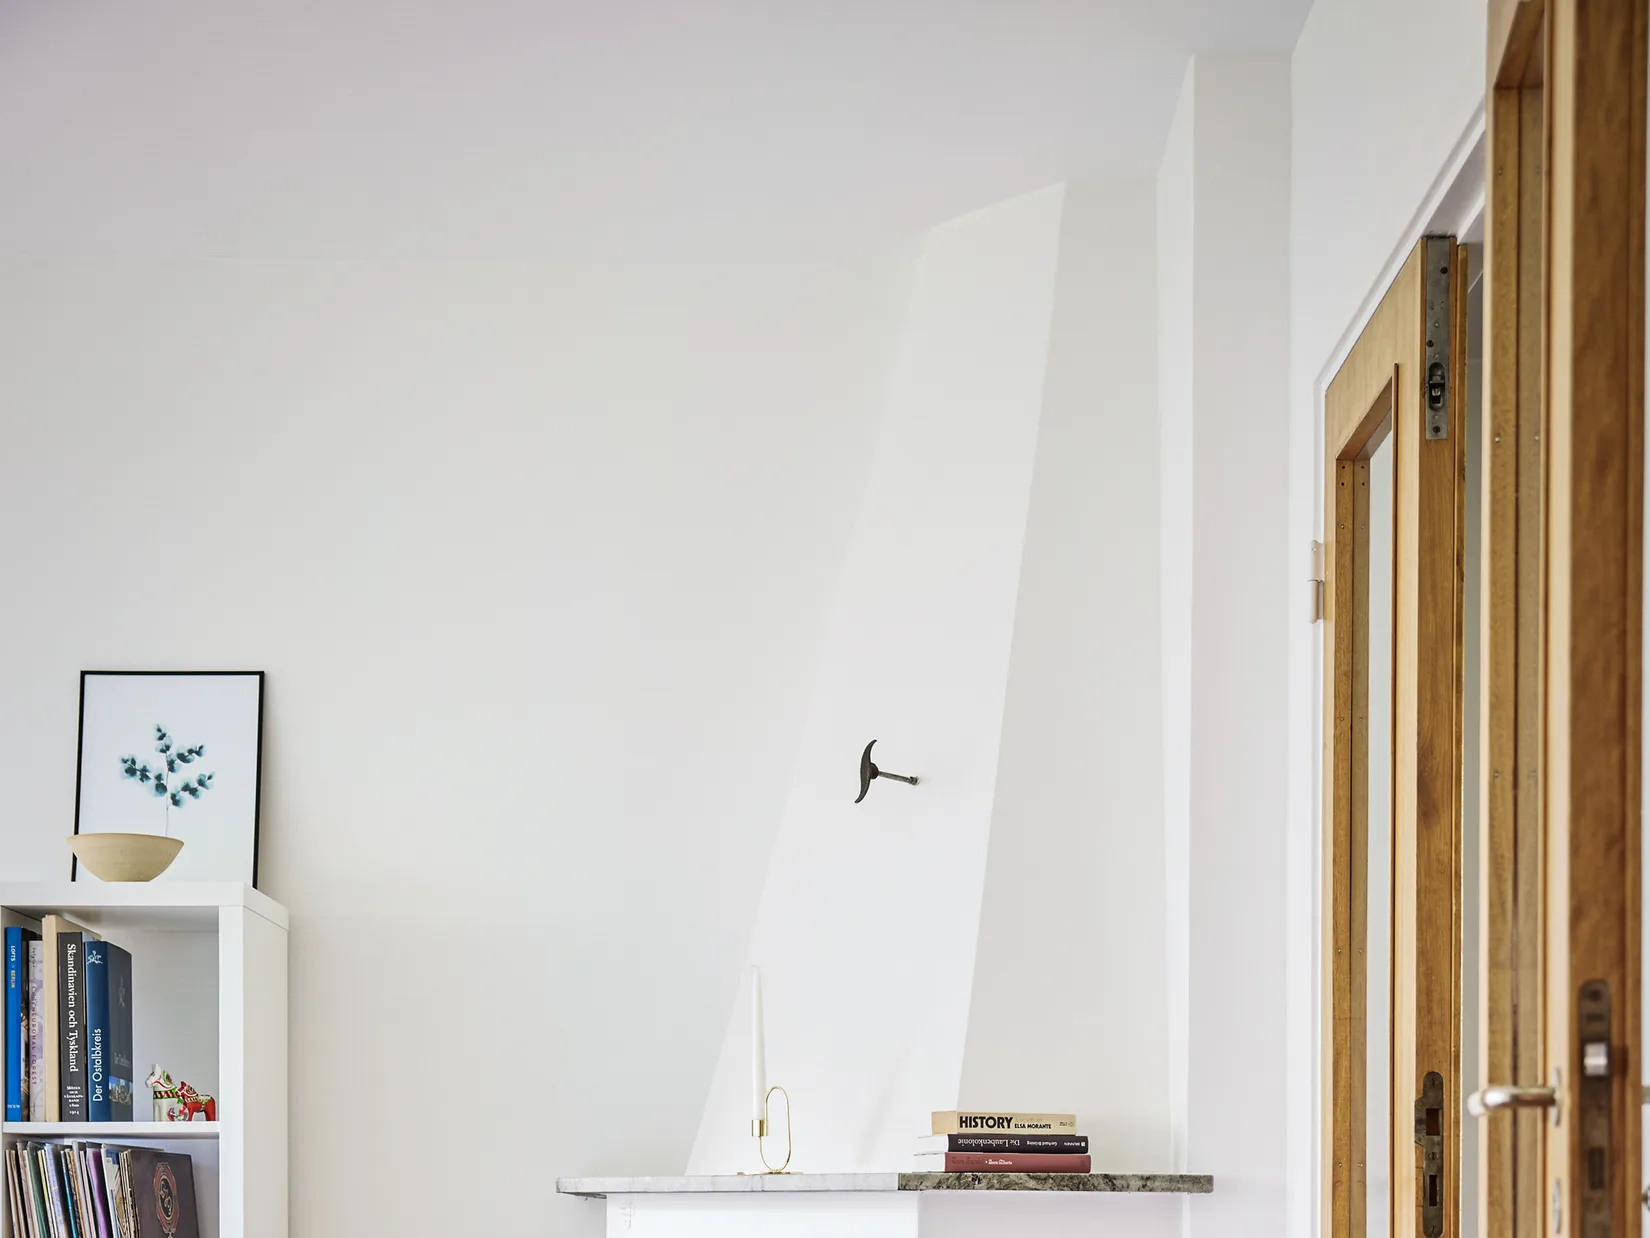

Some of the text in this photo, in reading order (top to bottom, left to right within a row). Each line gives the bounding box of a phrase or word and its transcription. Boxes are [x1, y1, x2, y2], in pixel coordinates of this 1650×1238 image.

[66, 943, 79, 1072] Skandinavien och Tyskland
[91, 1028, 103, 1102] Der Ostalbkreis
[957, 1138, 1009, 1147] Laubenkolonie
[959, 1116, 1013, 1129] HISTORY
